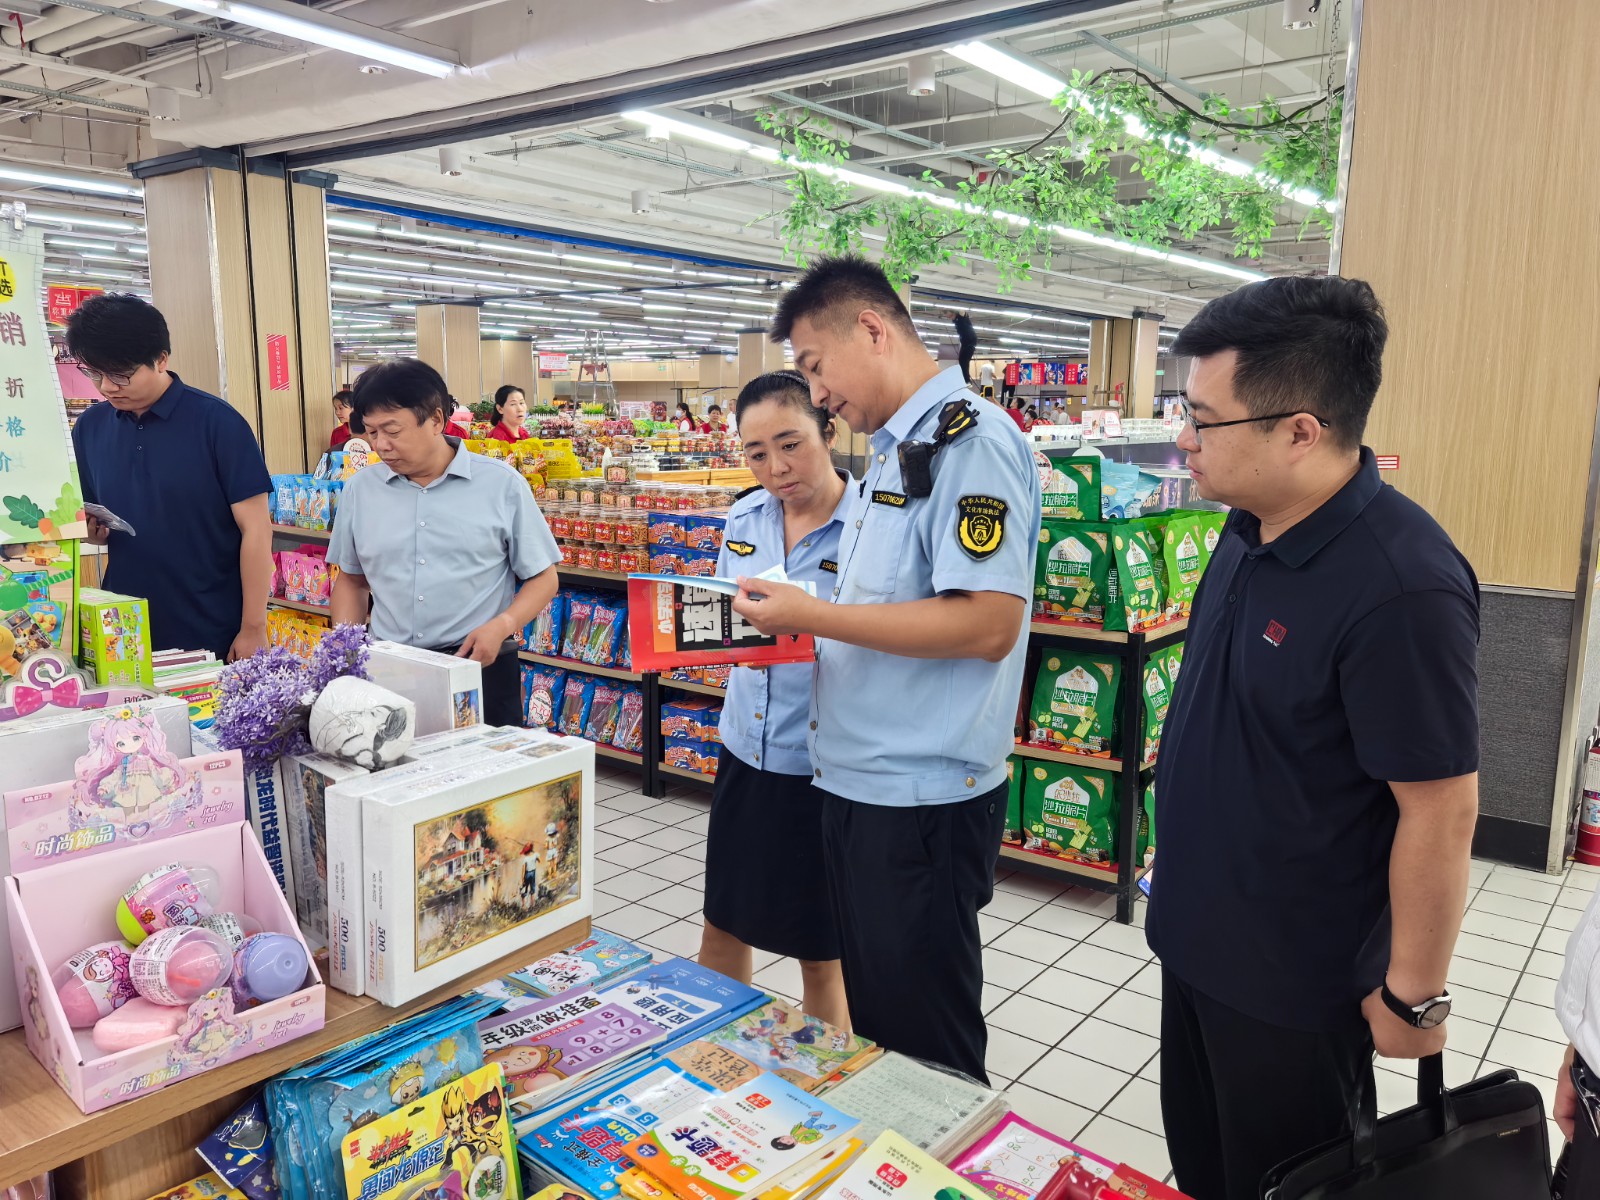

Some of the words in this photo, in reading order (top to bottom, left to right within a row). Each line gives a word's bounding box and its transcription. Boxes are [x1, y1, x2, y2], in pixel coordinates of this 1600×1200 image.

[5, 377, 24, 398] 折
[6, 416, 26, 438] 格
[961, 497, 1005, 510] 中华人民共和国
[965, 507, 1000, 516] 文化市场执法
[657, 582, 673, 634] 小学数学
[202, 800, 233, 815] jewelry
[203, 814, 217, 823] set
[34, 824, 116, 857] 时尚饰品
[341, 917, 349, 942] 500
[377, 926, 386, 952] 500
[533, 967, 580, 984] 米小圈
[601, 1011, 615, 1019] 8
[633, 996, 693, 1025] 应用题
[272, 1013, 305, 1034] jewelry
[613, 1019, 624, 1028] 7
[273, 1028, 287, 1040] set
[590, 1045, 603, 1054] 8
[708, 1047, 749, 1076] 笔记
[119, 1063, 182, 1096] 时尚饰品
[691, 1056, 735, 1086] 课堂
[640, 1115, 653, 1123] 5
[563, 1141, 605, 1168] 全横式
[671, 1126, 761, 1183] 口算题卡
[1007, 1142, 1021, 1151] 20
[880, 1170, 901, 1187] 四年级
[888, 1167, 903, 1178] 上册
[1021, 1178, 1035, 1187] 15
